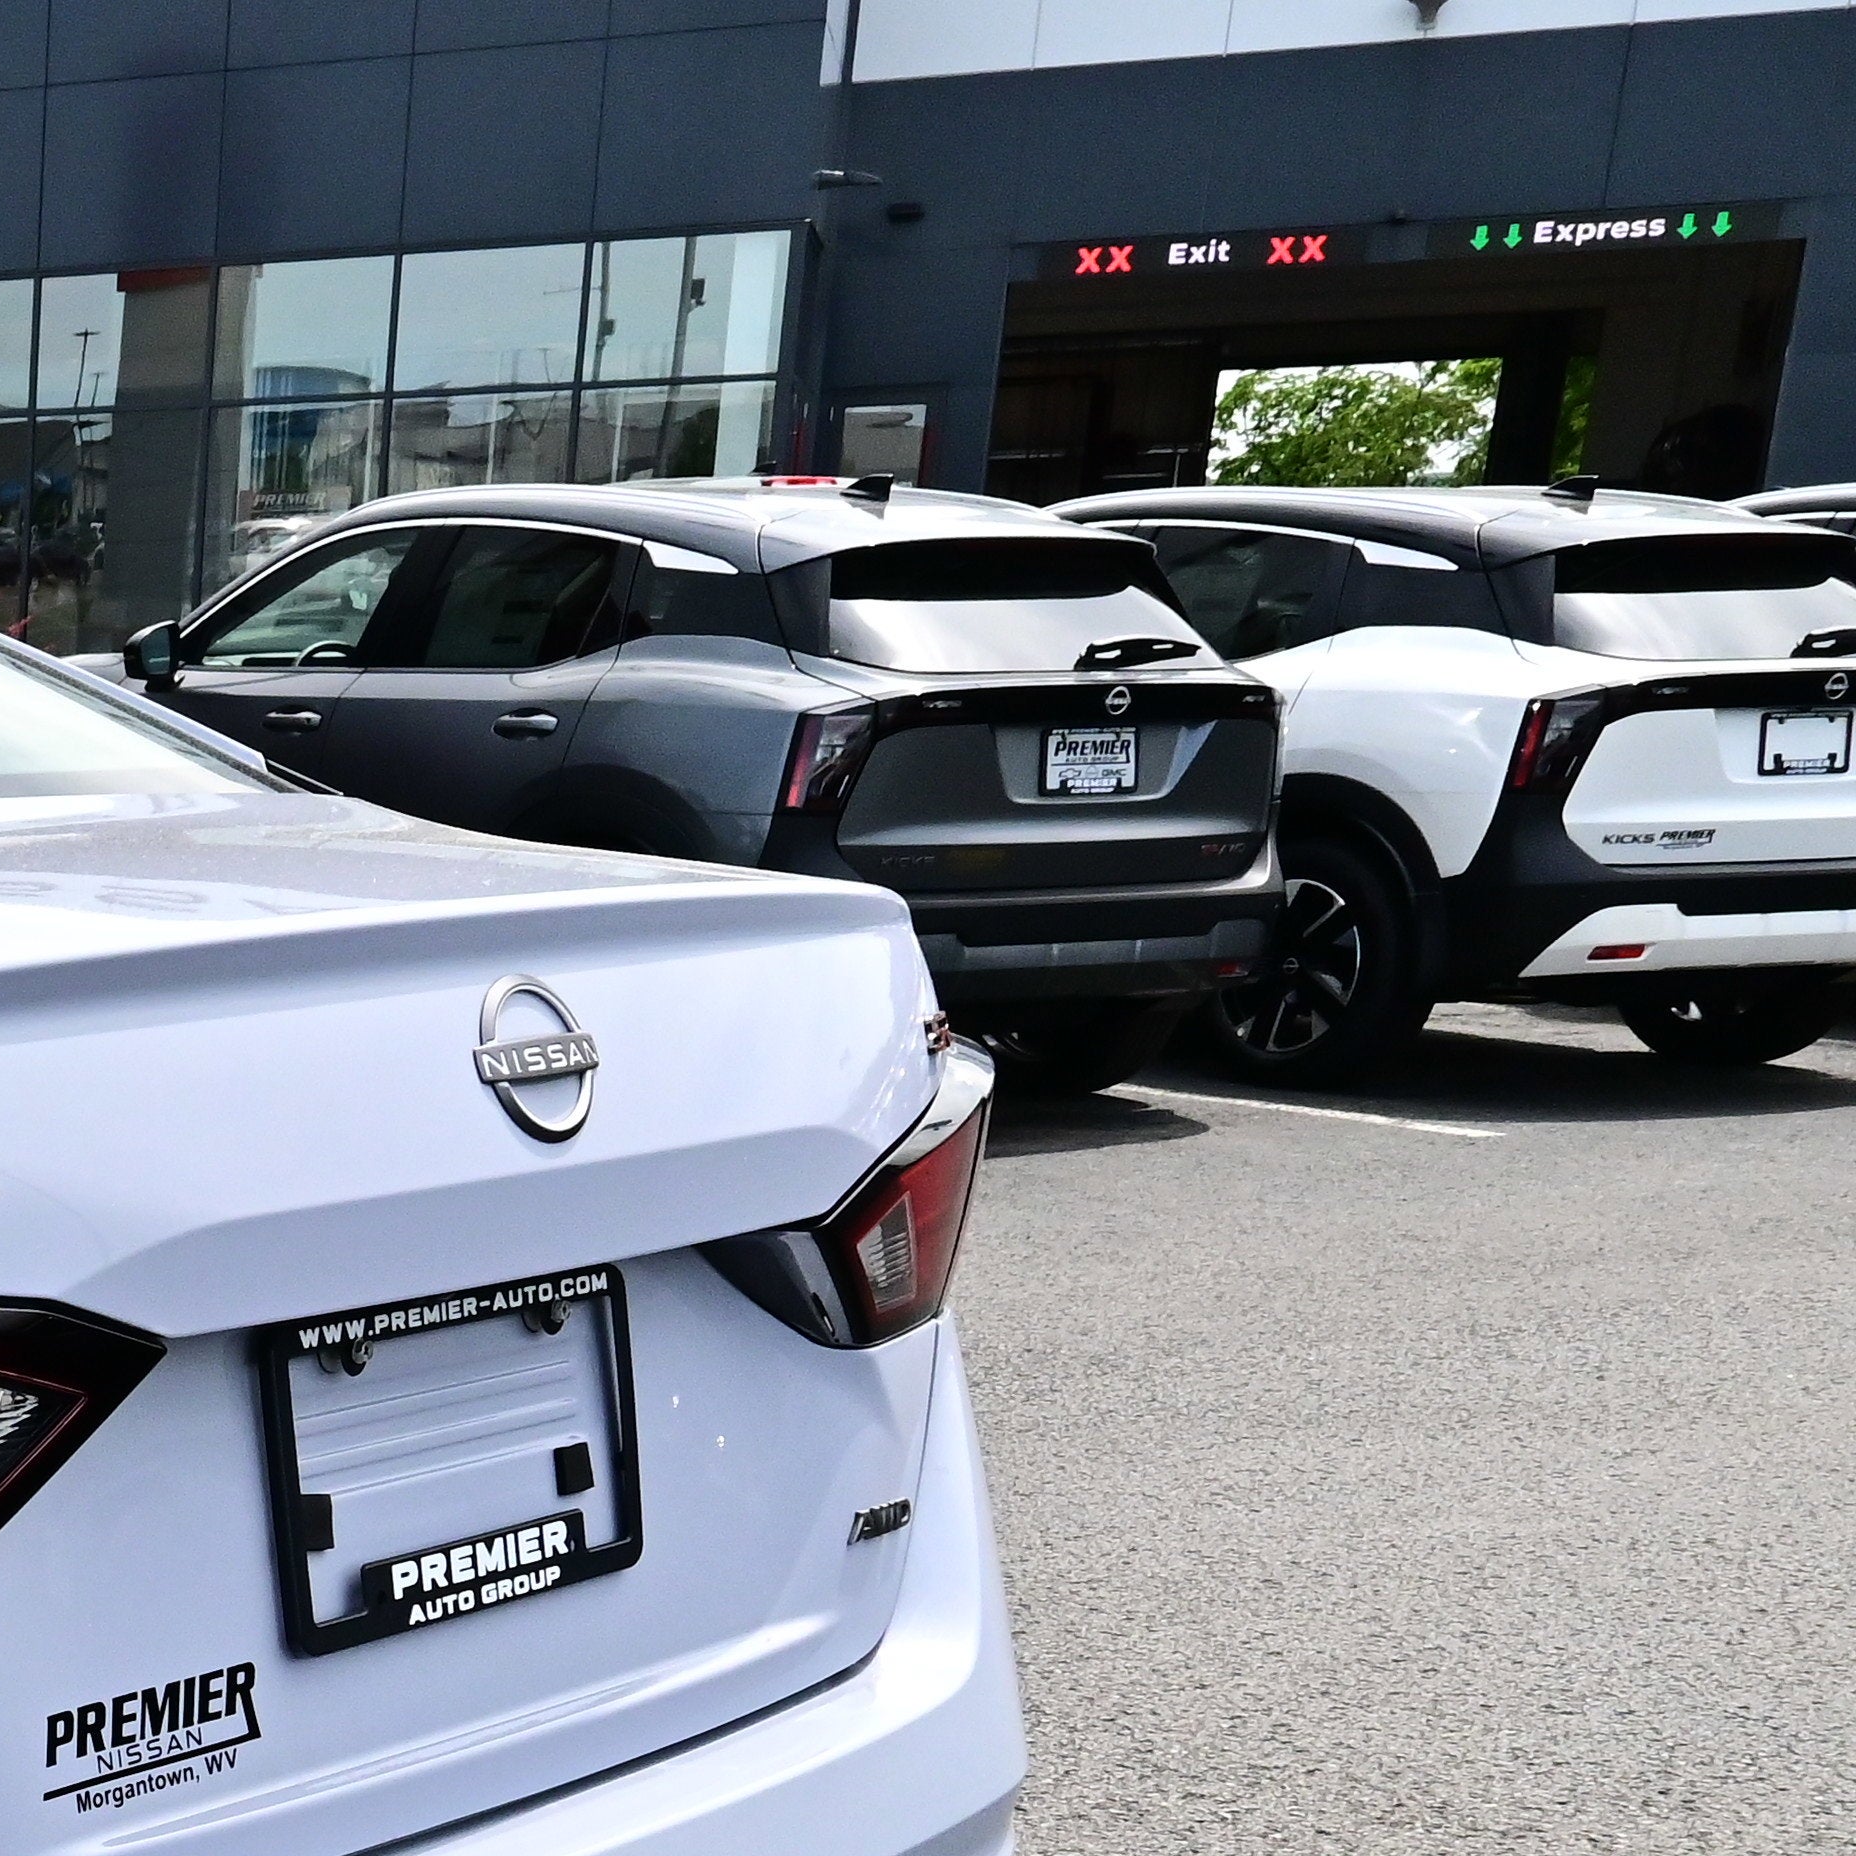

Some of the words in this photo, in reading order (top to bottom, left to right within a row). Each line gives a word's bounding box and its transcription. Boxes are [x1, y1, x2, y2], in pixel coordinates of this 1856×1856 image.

[1168, 239, 1231, 265] Exit
[1533, 218, 1666, 247] Express
[1053, 739, 1132, 763] PREMIER
[1601, 833, 1656, 844] KICKS
[481, 1039, 599, 1078] NISSAN
[299, 1272, 608, 1349] WWW.PREMIER-AUTO.COM
[391, 1520, 569, 1600] PREMIER
[409, 1590, 475, 1626] AUTO
[480, 1565, 561, 1605] GROUP
[45, 1661, 262, 1768] PREMIER
[96, 1727, 203, 1774] NISSAN
[76, 1766, 200, 1814] Morgantown,
[204, 1748, 237, 1775] WV
